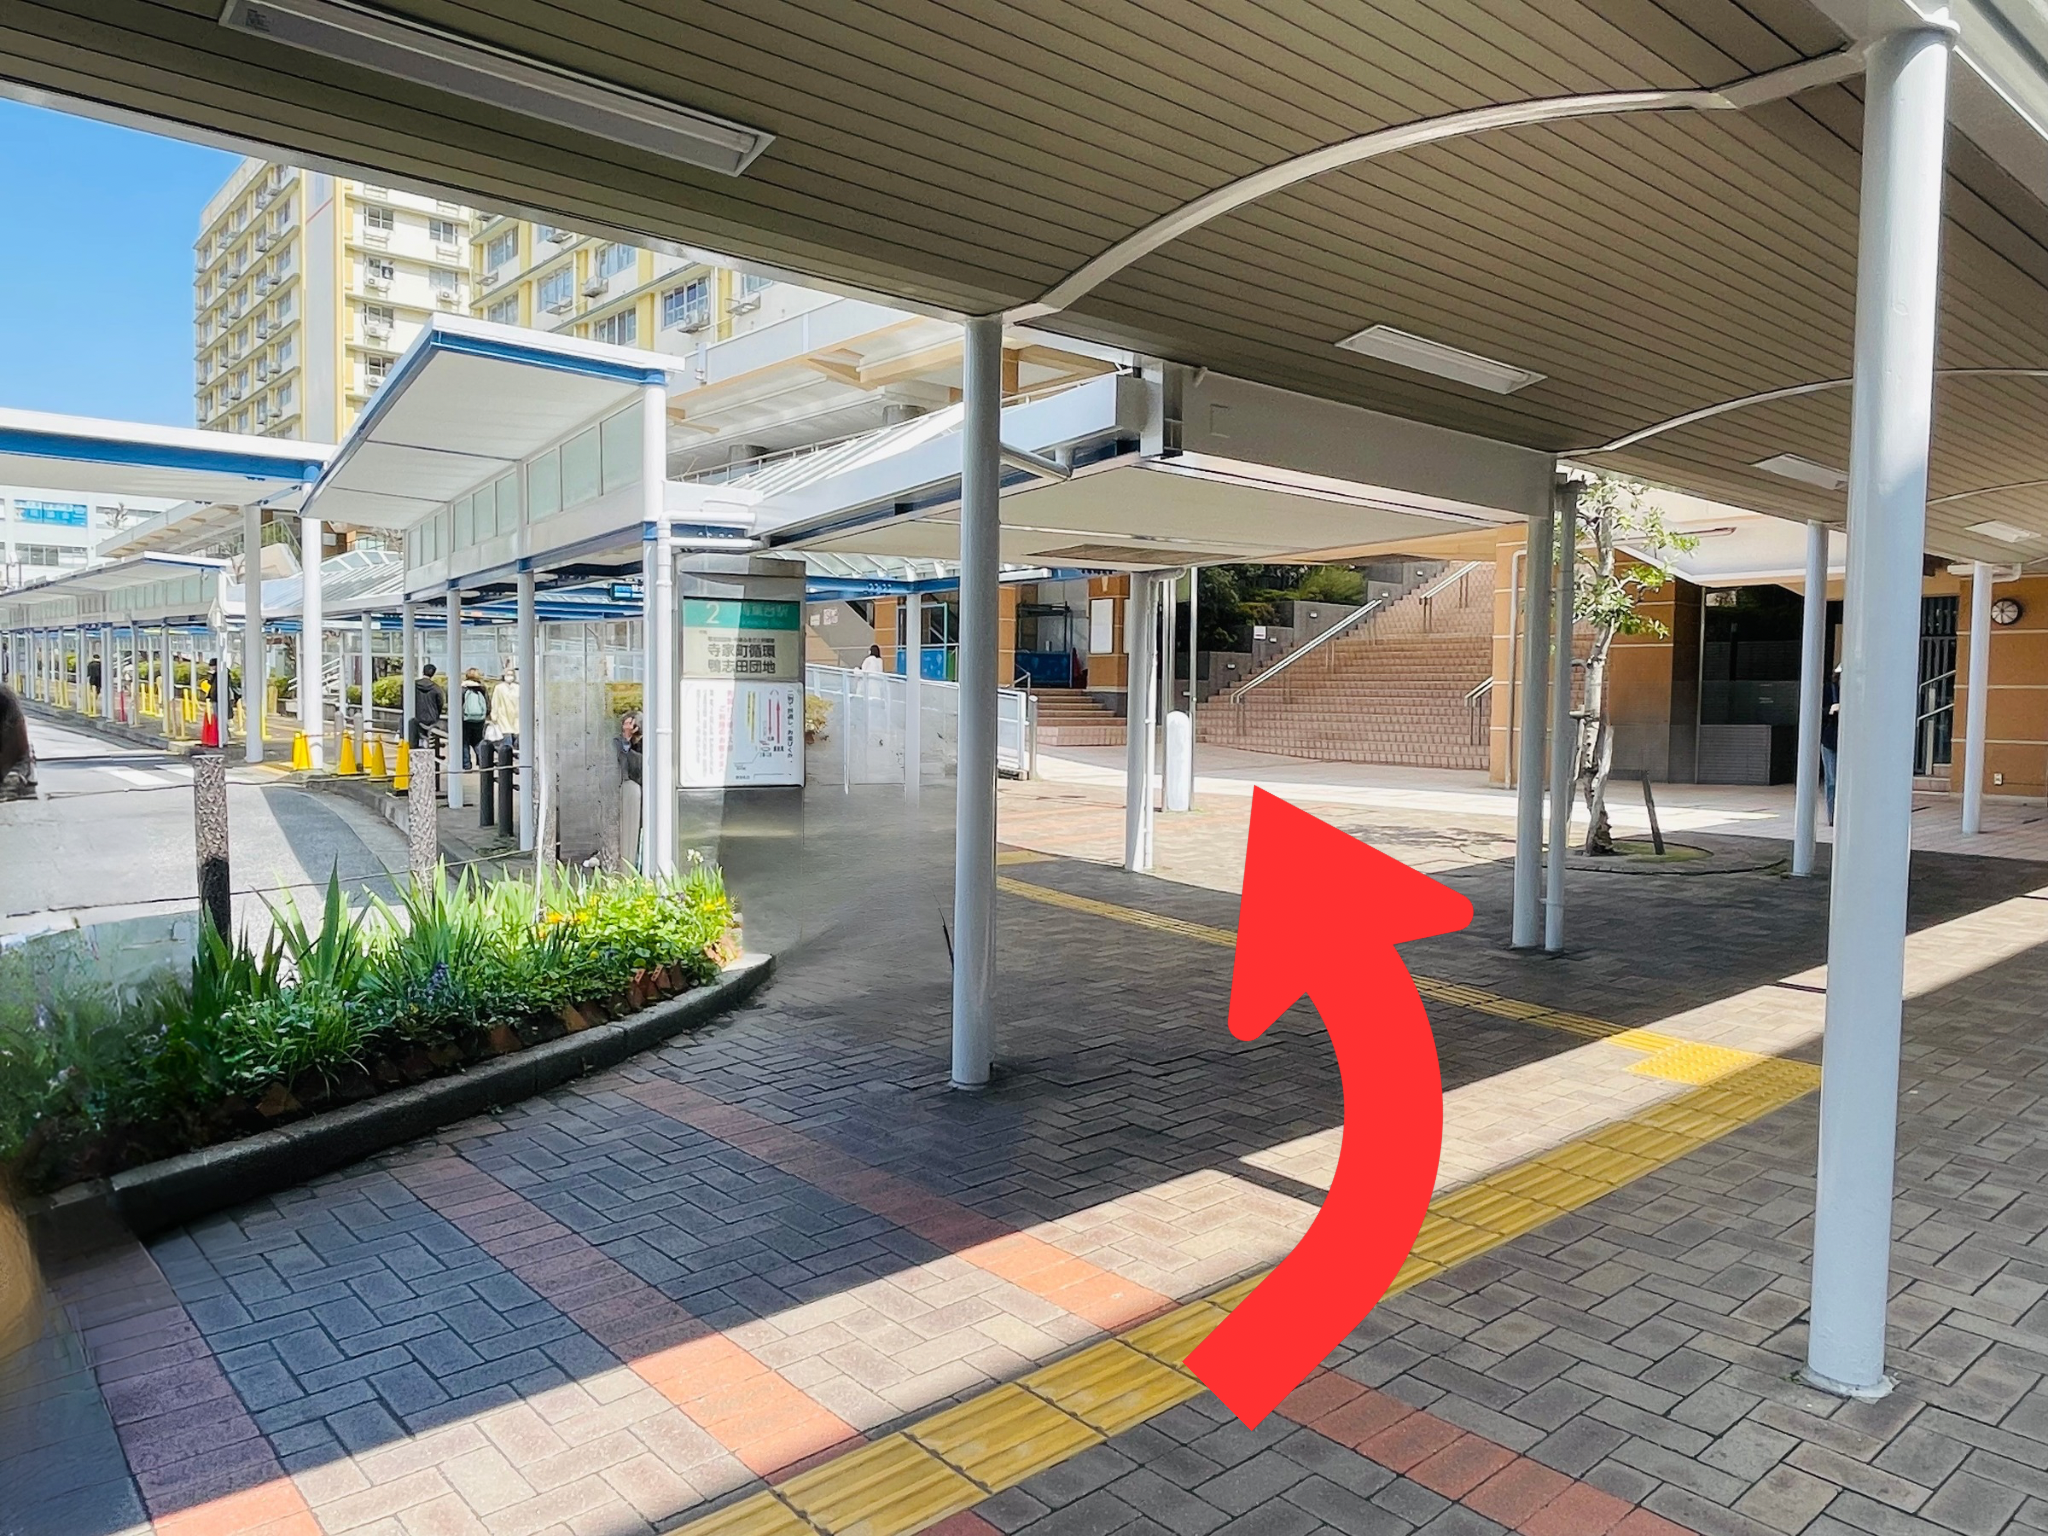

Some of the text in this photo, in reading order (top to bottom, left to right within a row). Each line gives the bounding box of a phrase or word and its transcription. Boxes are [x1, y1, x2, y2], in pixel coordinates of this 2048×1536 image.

[706, 602, 720, 624] 2
[707, 643, 776, 658] 寺家町循環
